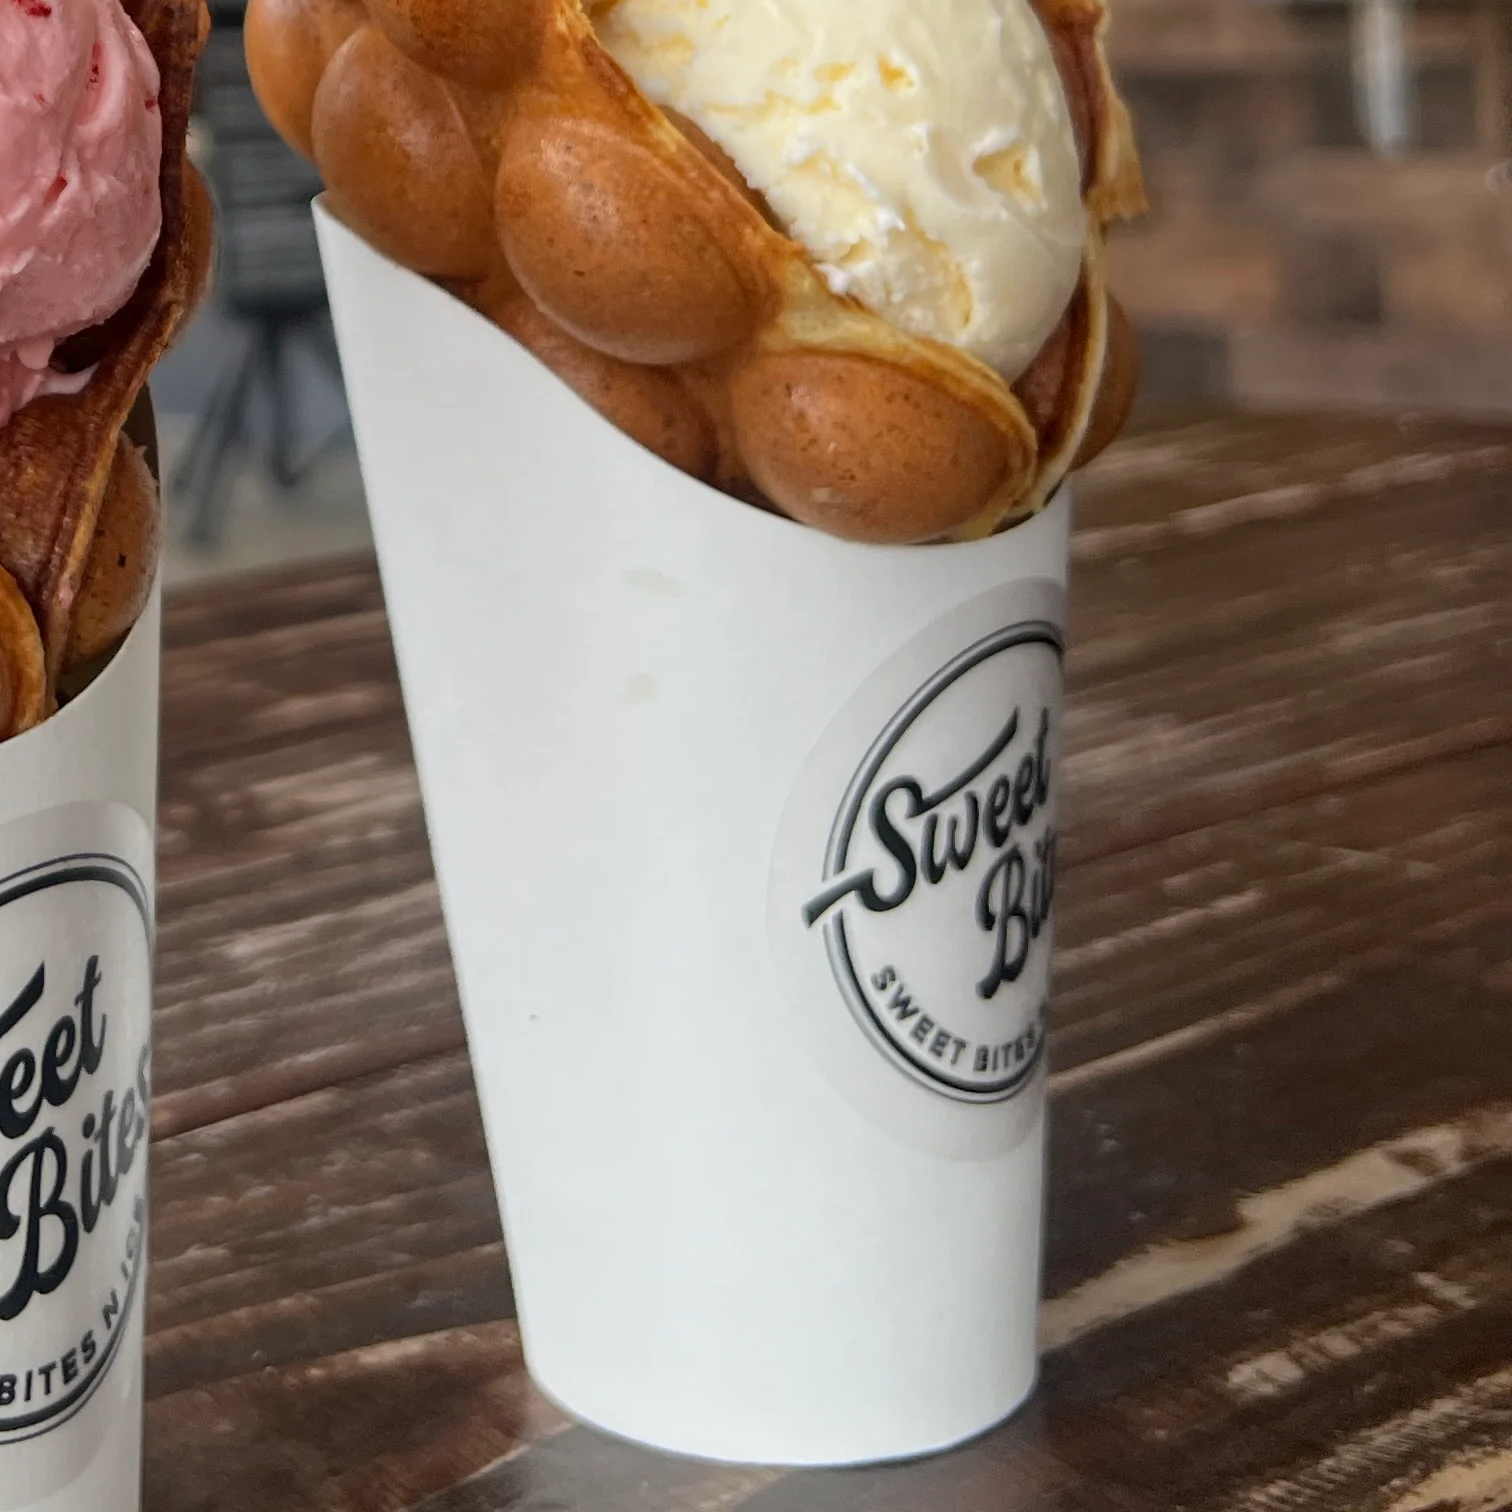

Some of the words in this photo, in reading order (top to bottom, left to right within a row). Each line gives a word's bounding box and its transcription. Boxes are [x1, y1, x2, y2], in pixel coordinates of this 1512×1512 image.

[802, 706, 1051, 928] Sweet
[871, 964, 967, 1066] SWEET
[973, 1022, 1037, 1072] BITES
